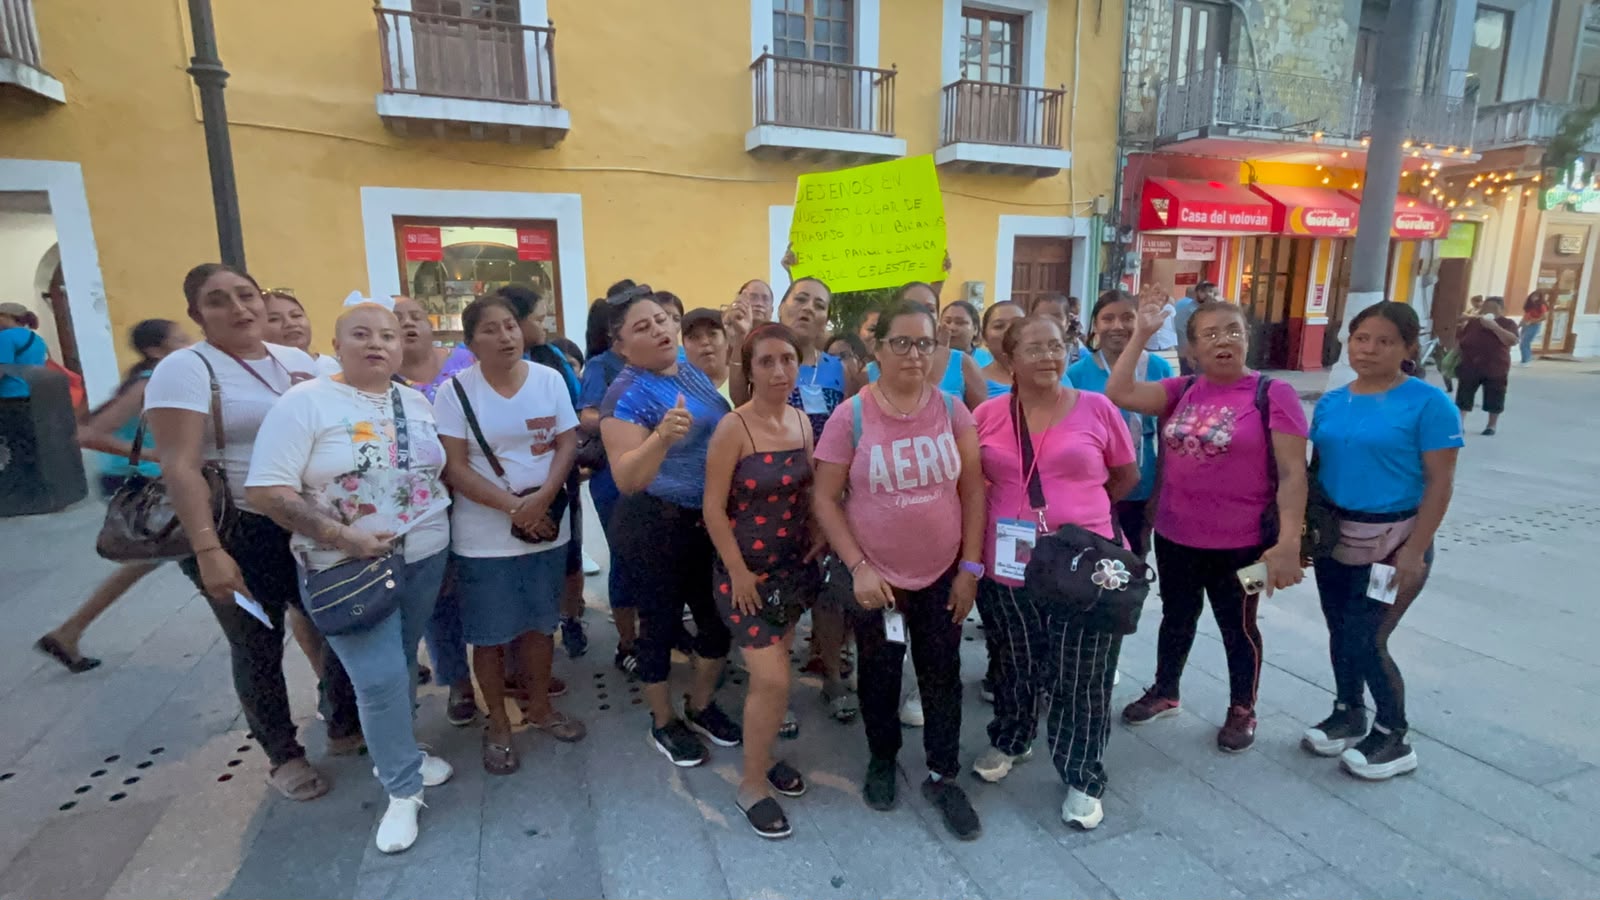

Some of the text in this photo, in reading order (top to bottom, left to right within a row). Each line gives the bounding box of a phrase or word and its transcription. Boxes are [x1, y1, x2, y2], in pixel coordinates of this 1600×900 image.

[881, 170, 901, 190] EN
[855, 201, 899, 216] LUGAR
[904, 198, 922, 211] DE
[1181, 208, 1268, 226] Casa del volován
[791, 229, 845, 243] TRABAJO
[821, 253, 838, 262] EL
[857, 259, 917, 279] CELESTE
[869, 433, 961, 493] AERO
